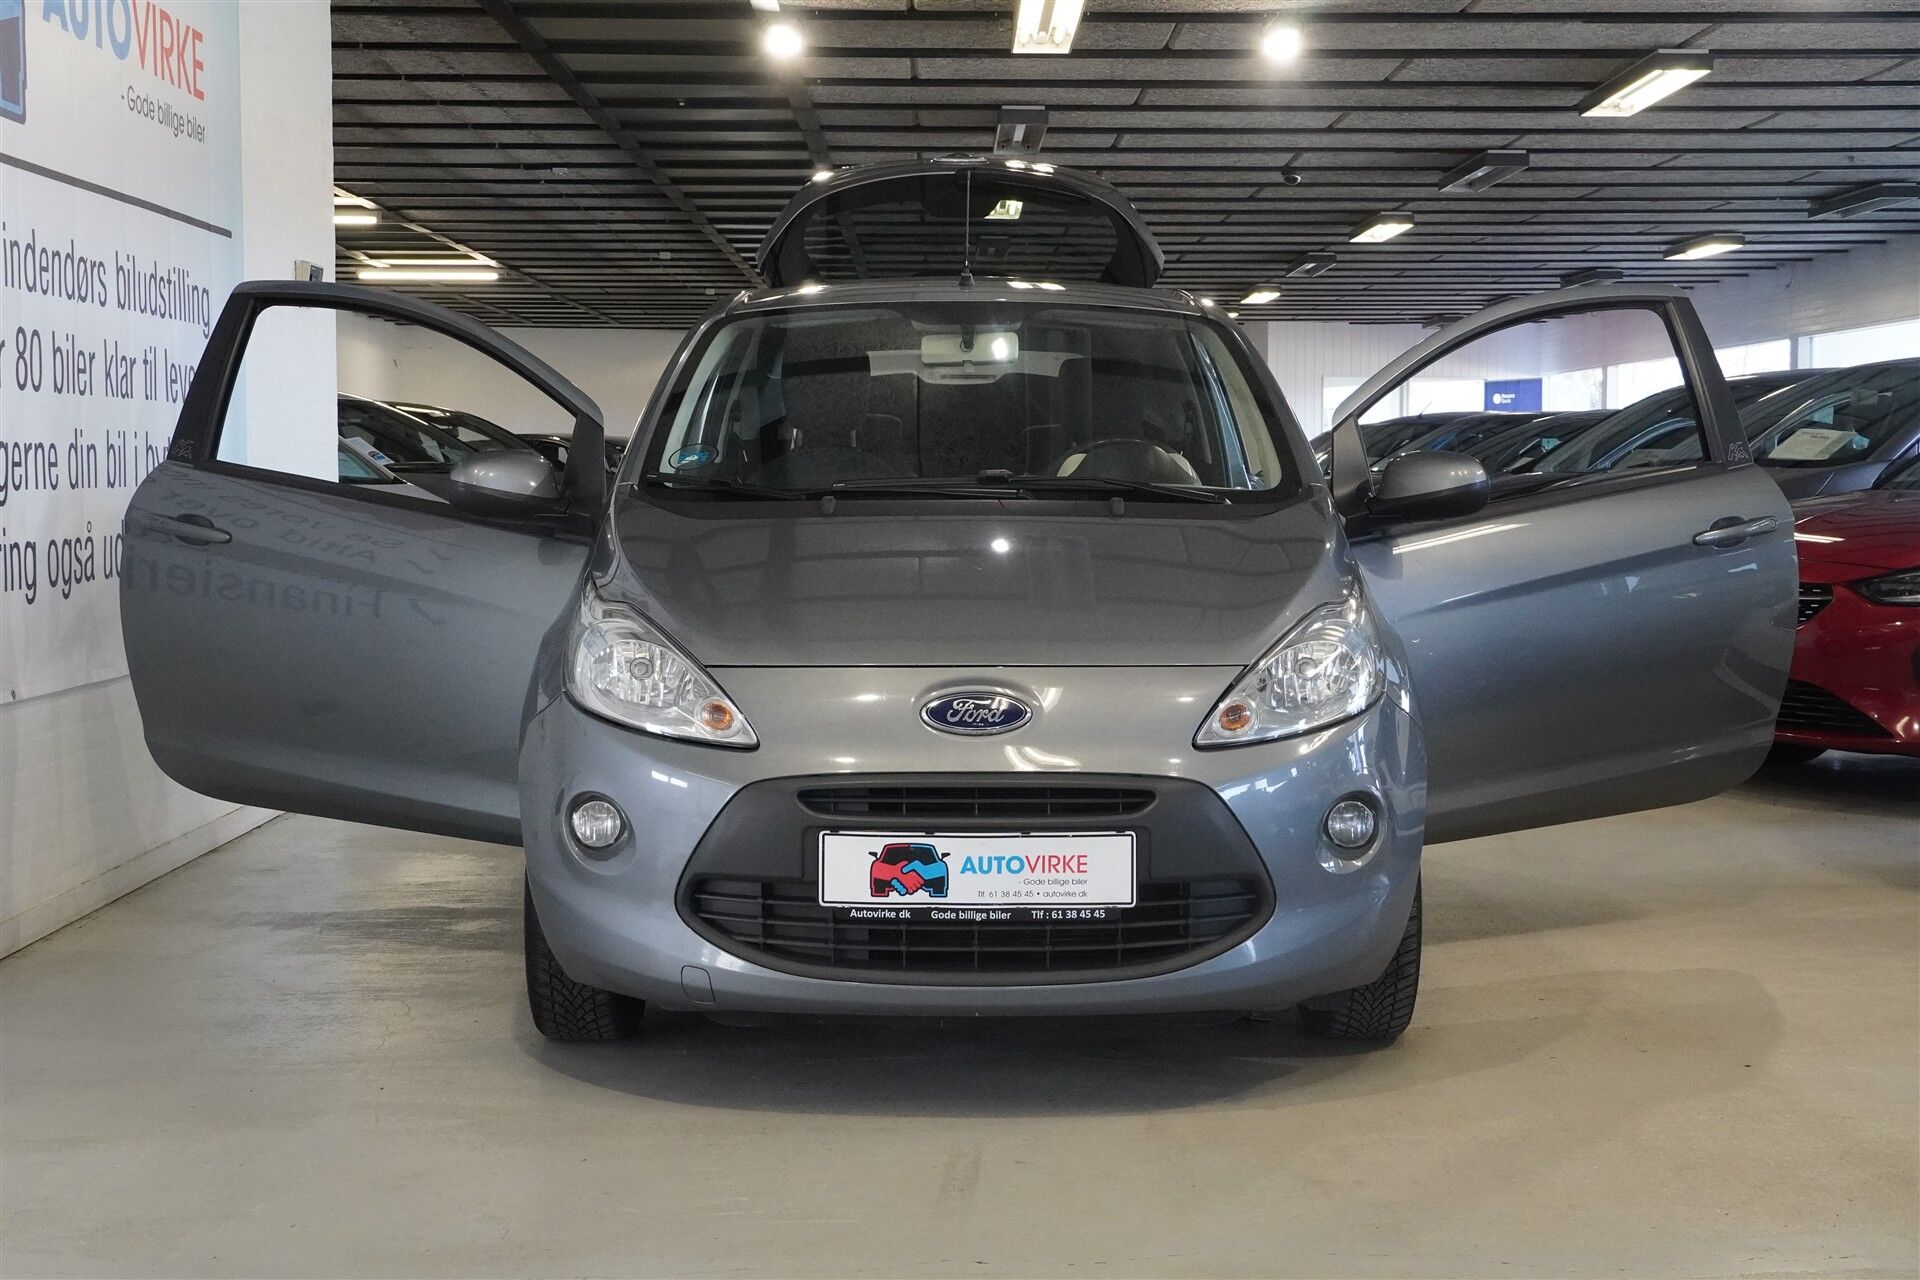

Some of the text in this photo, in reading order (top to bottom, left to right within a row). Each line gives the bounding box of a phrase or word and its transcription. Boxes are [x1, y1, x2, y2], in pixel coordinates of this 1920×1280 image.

[127, 85, 155, 121] Gode
[157, 98, 185, 138] billige
[186, 112, 206, 143] biler
[3, 221, 211, 340] indendørs biludstilling
[15, 326, 43, 393] 80
[52, 330, 96, 396] biler
[103, 338, 137, 400] klar
[142, 345, 157, 401] til
[67, 427, 98, 490] din
[106, 429, 126, 489] bil
[133, 431, 138, 488] i
[0, 527, 37, 605] ing
[47, 520, 96, 600] også
[946, 698, 1005, 722] Ford
[959, 855, 1088, 875] AUTOVIRKE
[1023, 878, 1046, 886] Gode
[1047, 877, 1069, 888] billige
[1071, 877, 1088, 886] biler
[988, 890, 998, 899] 61
[1000, 890, 1011, 899] 38
[1012, 890, 1022, 899] 45
[1024, 890, 1034, 899] 45
[849, 909, 912, 919] Autovirke dk
[930, 910, 1012, 921] Gode billige biler
[1031, 910, 1045, 919] Tlf
[1051, 910, 1063, 919] 61
[1065, 910, 1078, 919] 38
[1079, 909, 1092, 919] 45
[1093, 909, 1106, 919] 45
